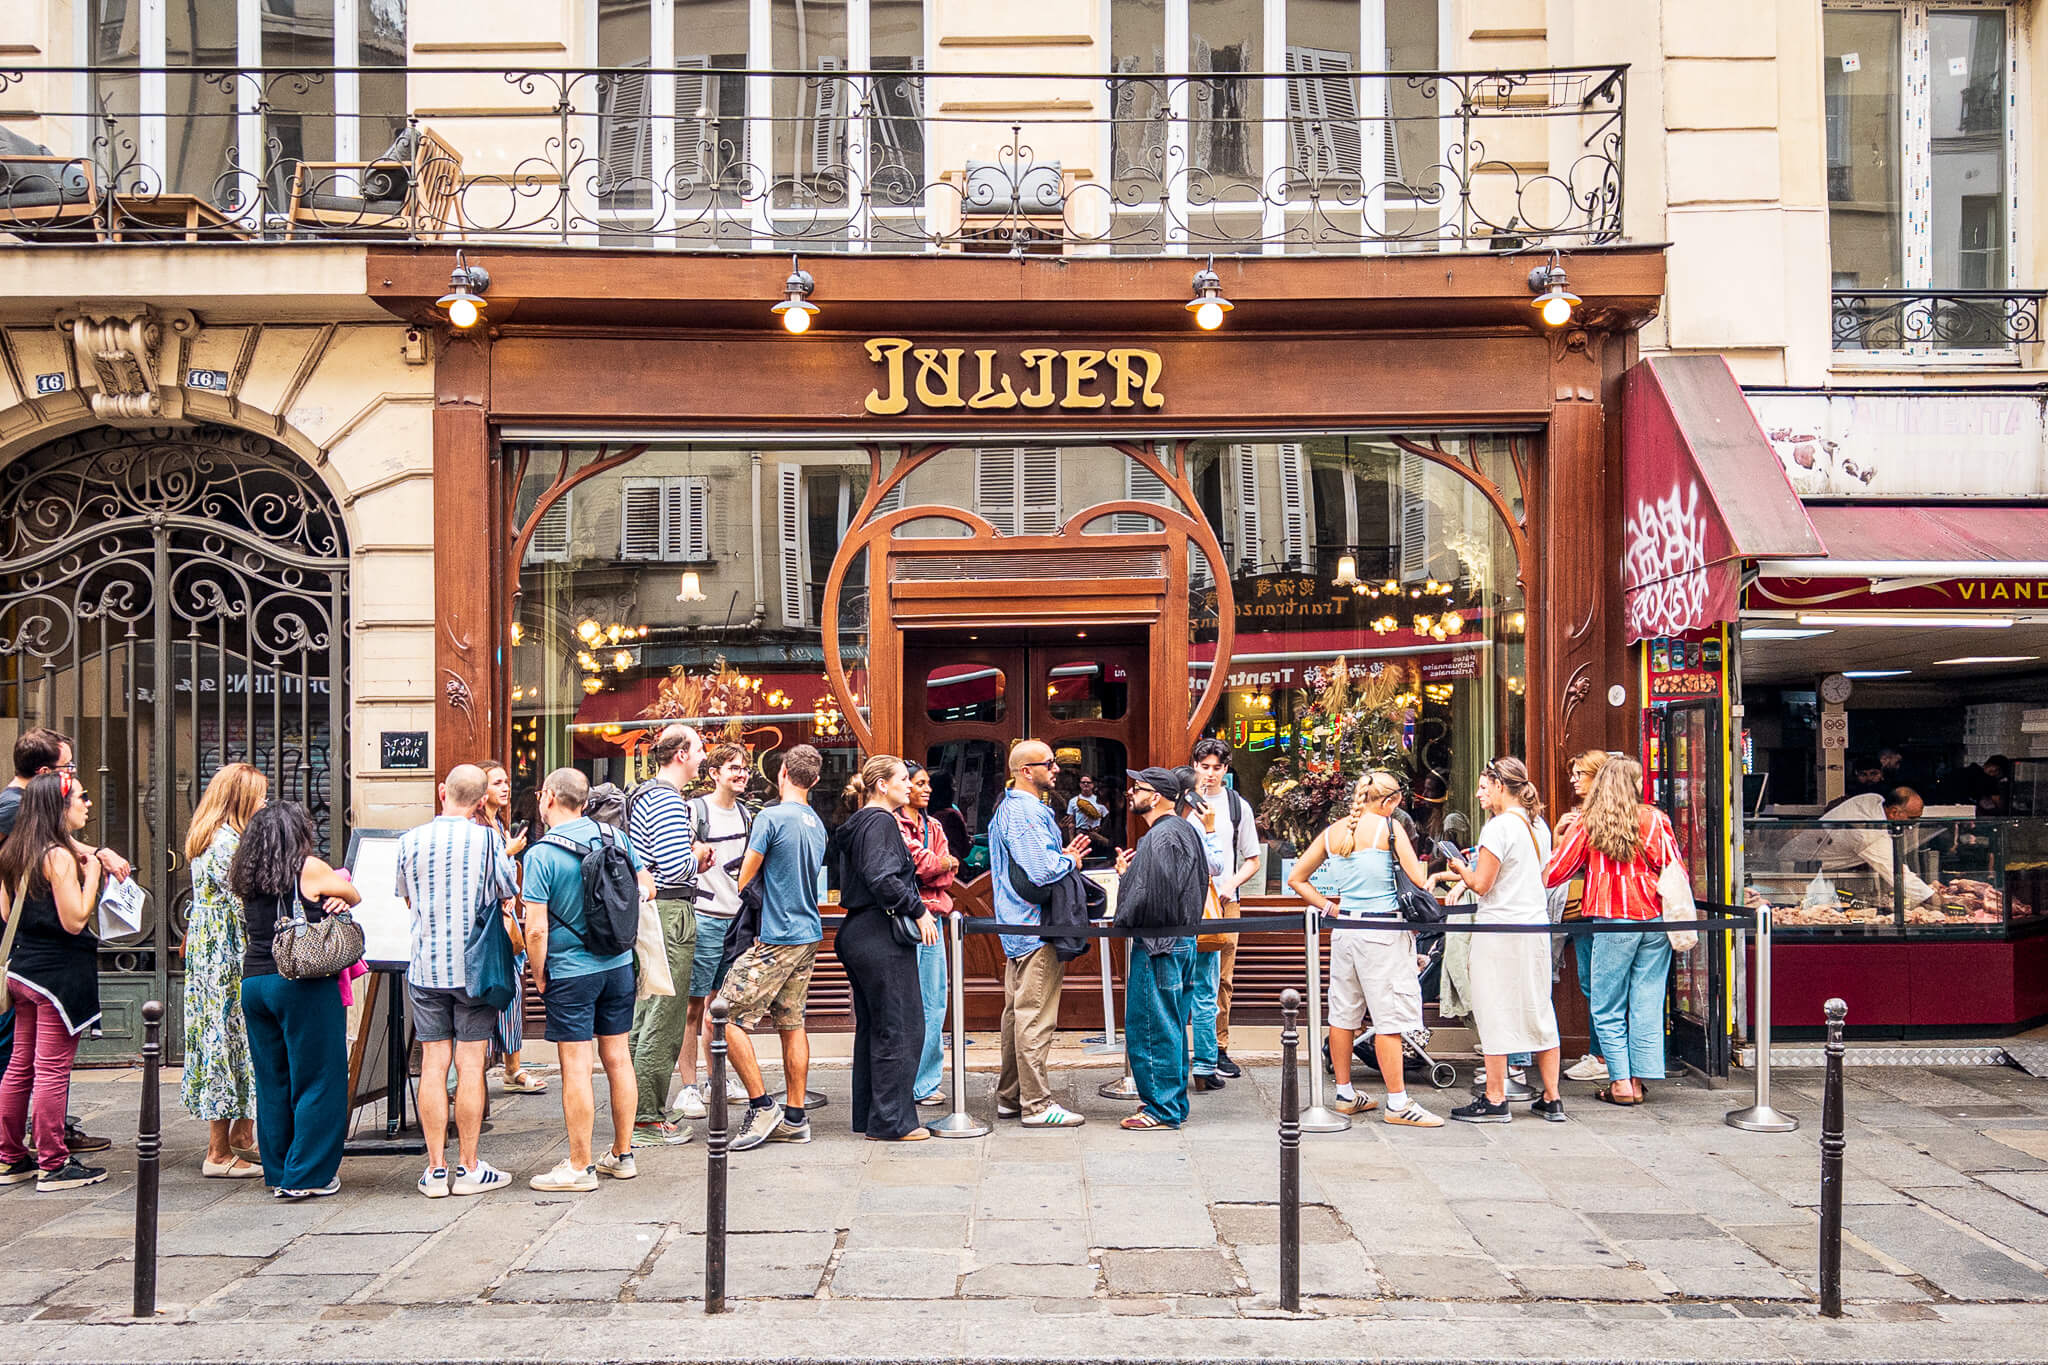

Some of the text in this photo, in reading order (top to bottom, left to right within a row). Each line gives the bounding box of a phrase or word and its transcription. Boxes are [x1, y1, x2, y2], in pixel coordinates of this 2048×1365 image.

[40, 375, 61, 390] 16
[192, 373, 212, 386] 16
[864, 338, 1164, 414] JULIEN
